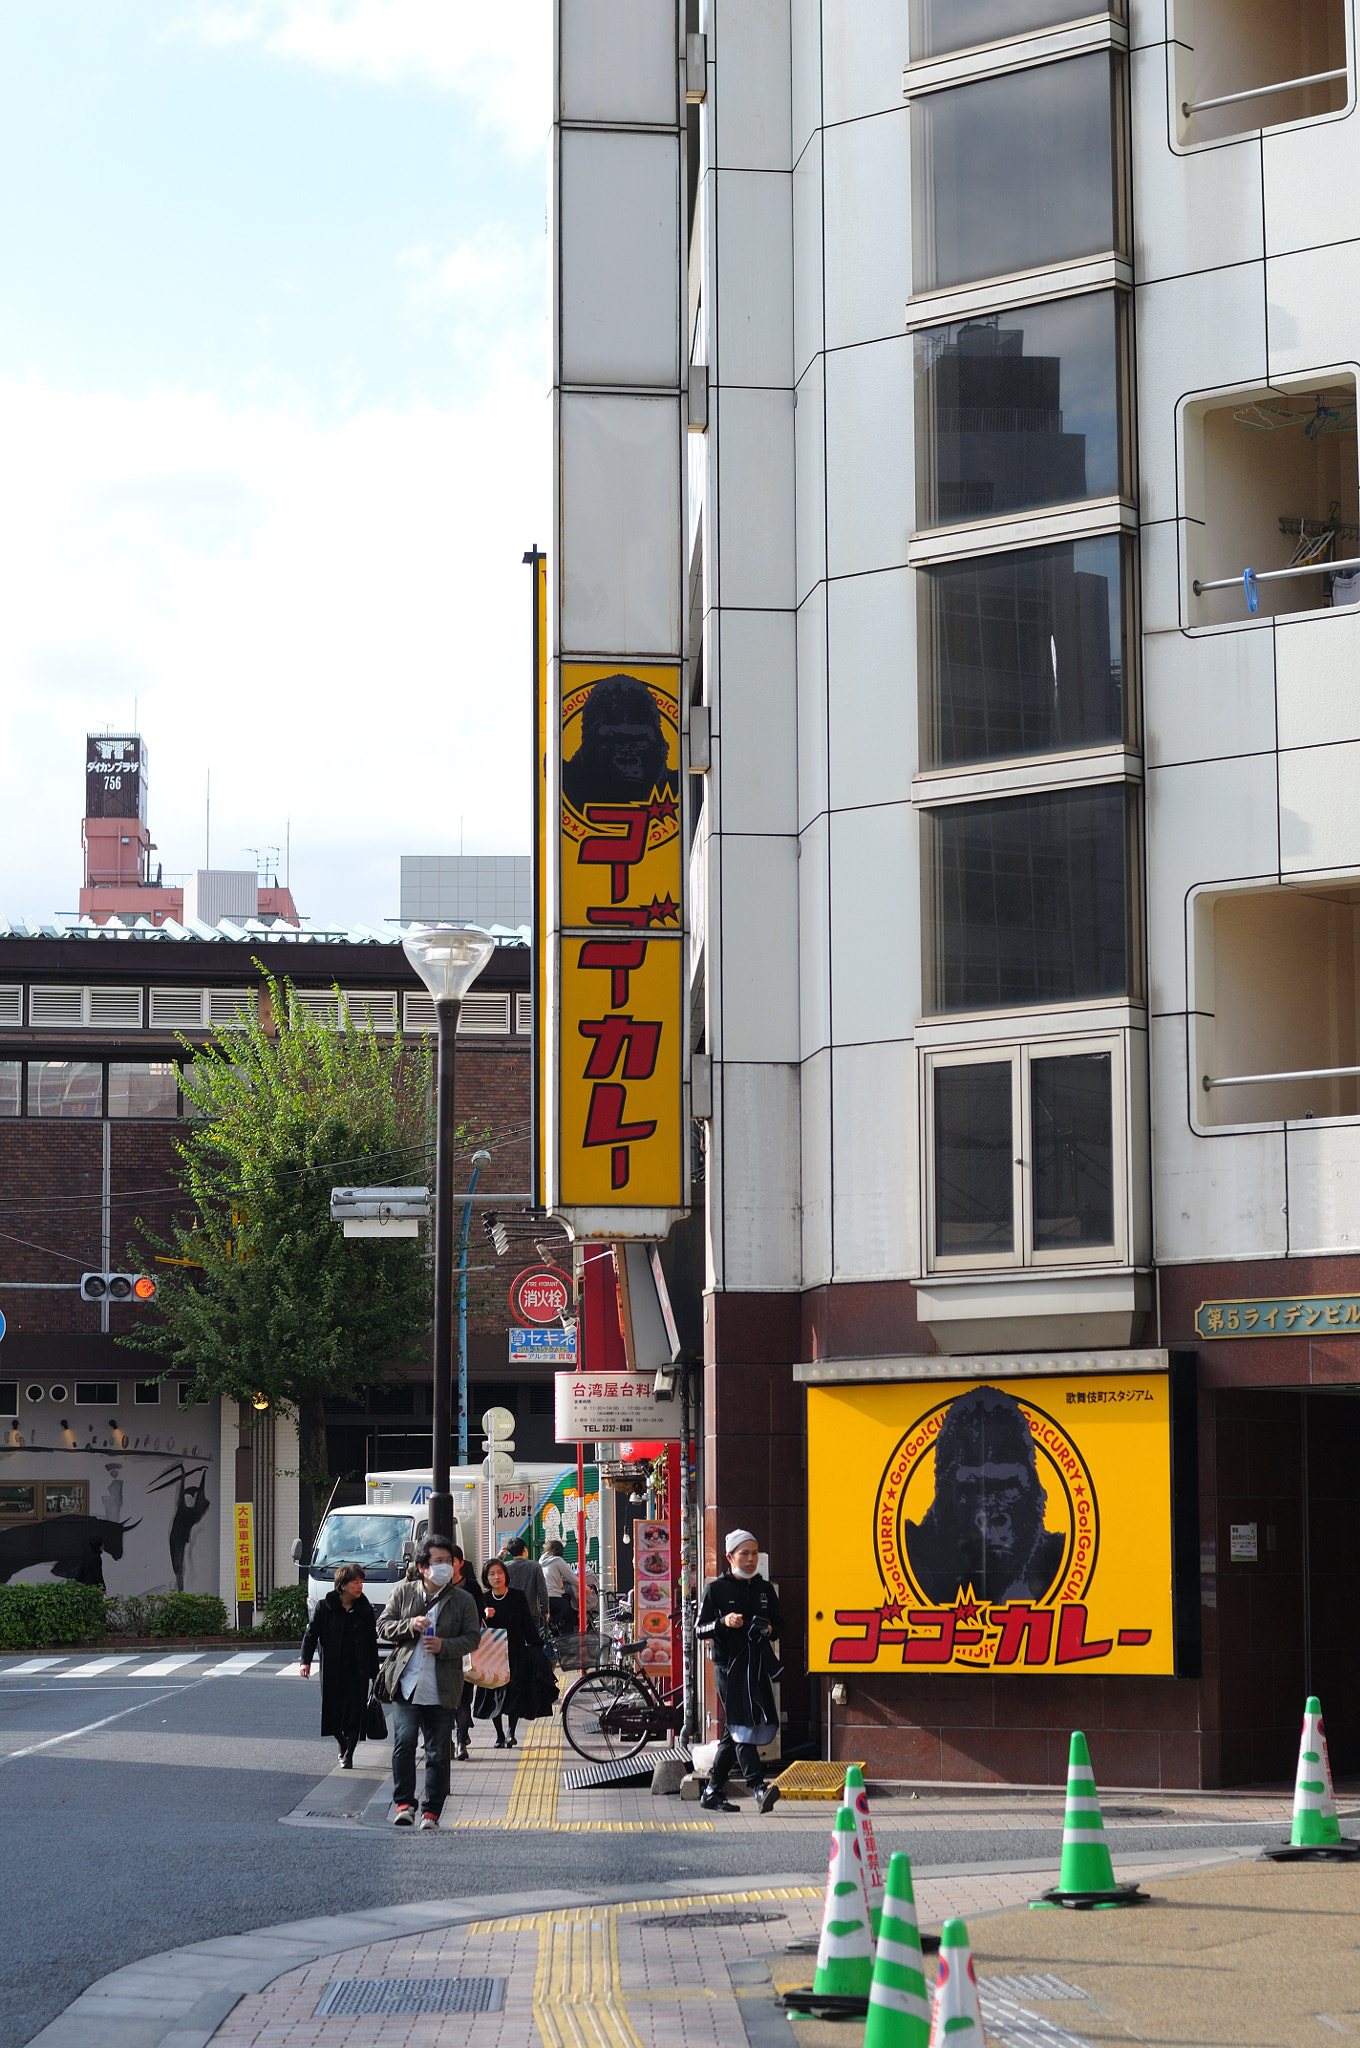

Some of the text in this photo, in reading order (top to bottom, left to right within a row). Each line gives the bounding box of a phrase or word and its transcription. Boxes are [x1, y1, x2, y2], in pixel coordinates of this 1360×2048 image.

[87, 761, 139, 773] ダイカンプラザ
[104, 776, 121, 790] 756
[577, 797, 680, 1190] ゴーゴーカレー
[524, 1289, 563, 1307] 消火栓
[1207, 1303, 1360, 1333] 第5ライデンビル
[527, 1330, 576, 1346] セキネ
[572, 1382, 656, 1398] 台湾屋台料
[1066, 1389, 1154, 1404] 歌舞伎町スタジアム
[502, 1492, 526, 1505] クリーン
[238, 1506, 251, 1591] 大型車右折禁止
[828, 1600, 1152, 1667] ゴーゴーカレー
[861, 1819, 884, 1888] 駐車禁止
